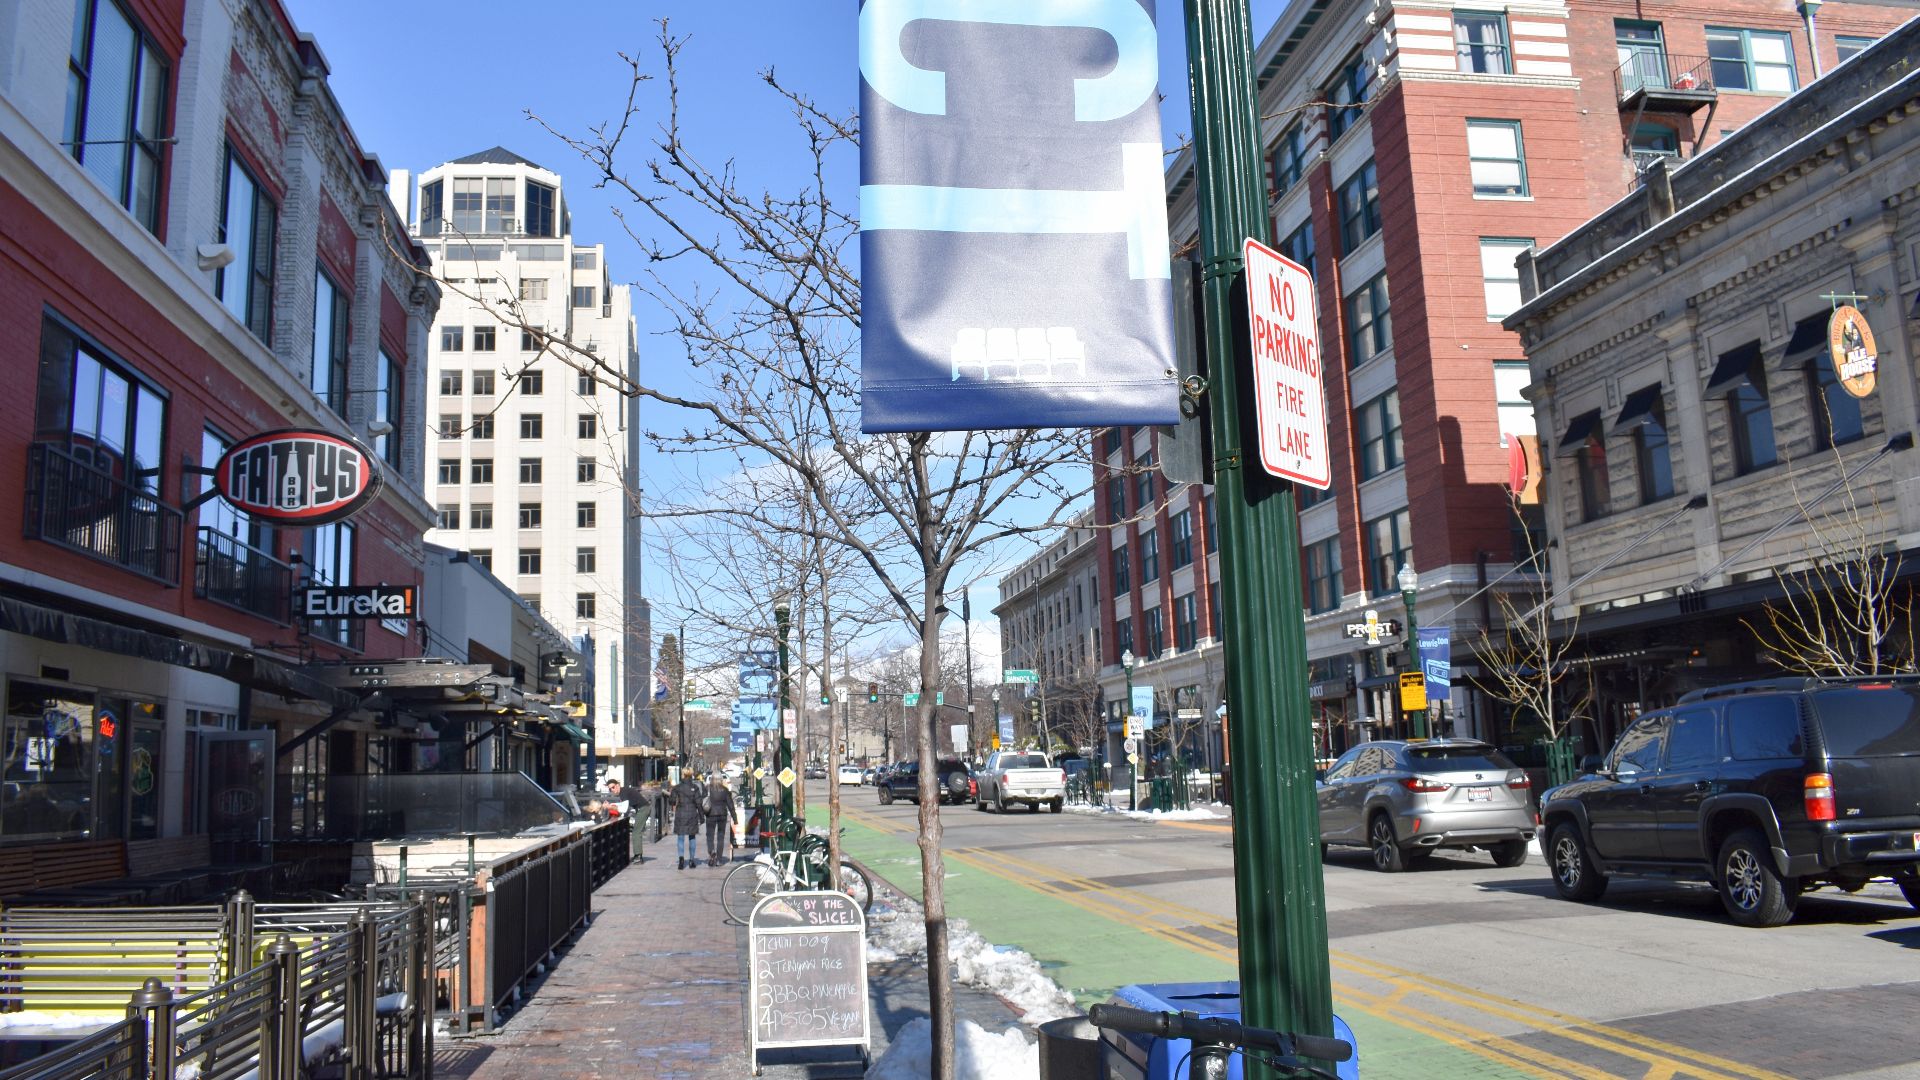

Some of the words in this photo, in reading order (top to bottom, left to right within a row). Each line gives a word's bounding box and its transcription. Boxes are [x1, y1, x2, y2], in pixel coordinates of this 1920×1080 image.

[1268, 273, 1295, 322] NO
[1255, 314, 1316, 378] PARKING
[1847, 346, 1867, 364] ALE
[1839, 356, 1877, 381] HOUSE
[1276, 381, 1306, 418] FIRE
[1277, 423, 1312, 460] LANE
[230, 438, 361, 510] FATTYS
[287, 476, 297, 506] BAR
[306, 588, 412, 616] Eureka!
[1419, 637, 1449, 648] Lewiston
[803, 899, 816, 911] BY
[823, 899, 844, 909] THE
[809, 911, 855, 925] SLICE!
[757, 937, 772, 955] 1
[759, 960, 775, 979] 2
[759, 984, 774, 1009] 3
[775, 985, 811, 1004] BBQ
[759, 1008, 774, 1038] 4
[812, 1007, 828, 1030] 5
